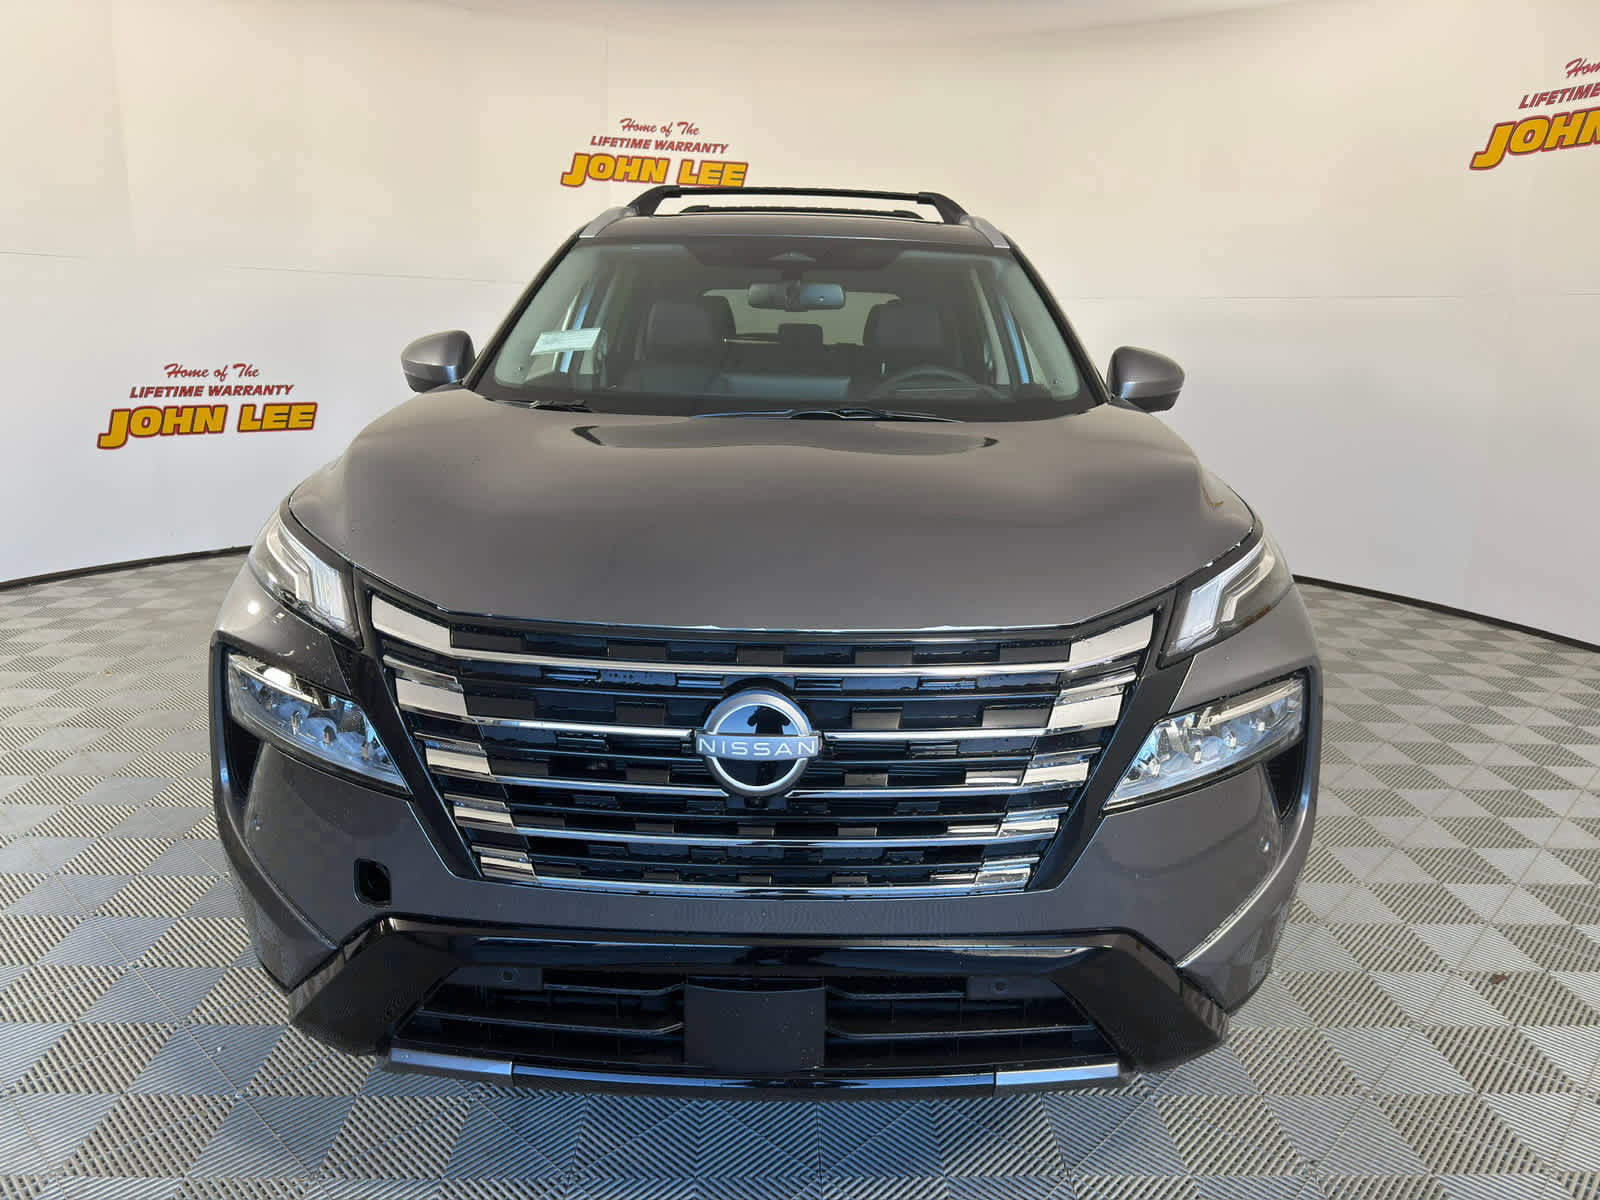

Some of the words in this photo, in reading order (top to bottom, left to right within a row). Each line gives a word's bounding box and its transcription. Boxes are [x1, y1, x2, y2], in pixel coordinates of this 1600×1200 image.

[1518, 82, 1600, 109] LIFETIME
[619, 117, 657, 134] Home
[660, 121, 673, 137] of
[676, 121, 700, 136] The
[590, 135, 652, 150] LIFETIME
[654, 139, 728, 154] WARRANTY
[560, 152, 670, 188] JOHN
[676, 158, 749, 187] LEE
[164, 363, 209, 379] Home
[213, 365, 228, 382] of
[232, 363, 260, 378] The
[129, 385, 205, 399] LIFETIME
[207, 384, 294, 397] WARRANTY
[97, 404, 229, 450] JOHN
[237, 402, 318, 433] LEE
[698, 738, 816, 757] NISSAN
